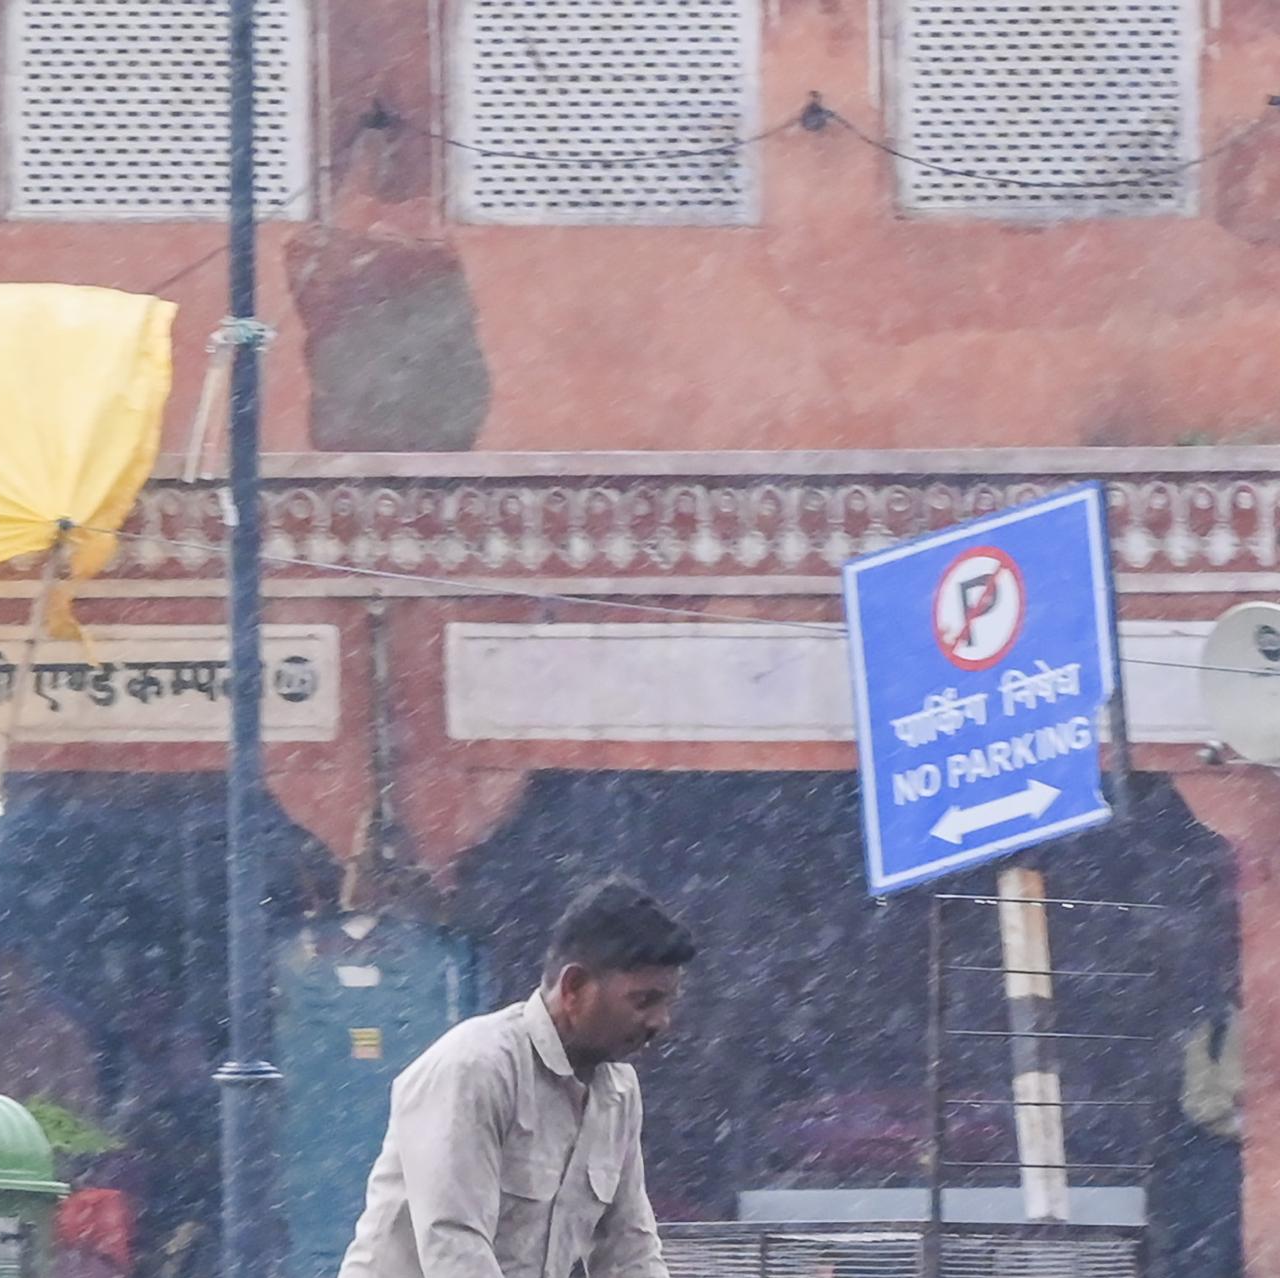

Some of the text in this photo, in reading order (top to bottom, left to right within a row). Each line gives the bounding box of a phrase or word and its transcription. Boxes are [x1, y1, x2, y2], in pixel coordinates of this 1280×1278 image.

[998, 660, 1082, 717] निषेध
[892, 716, 1093, 806] NO PARKING
